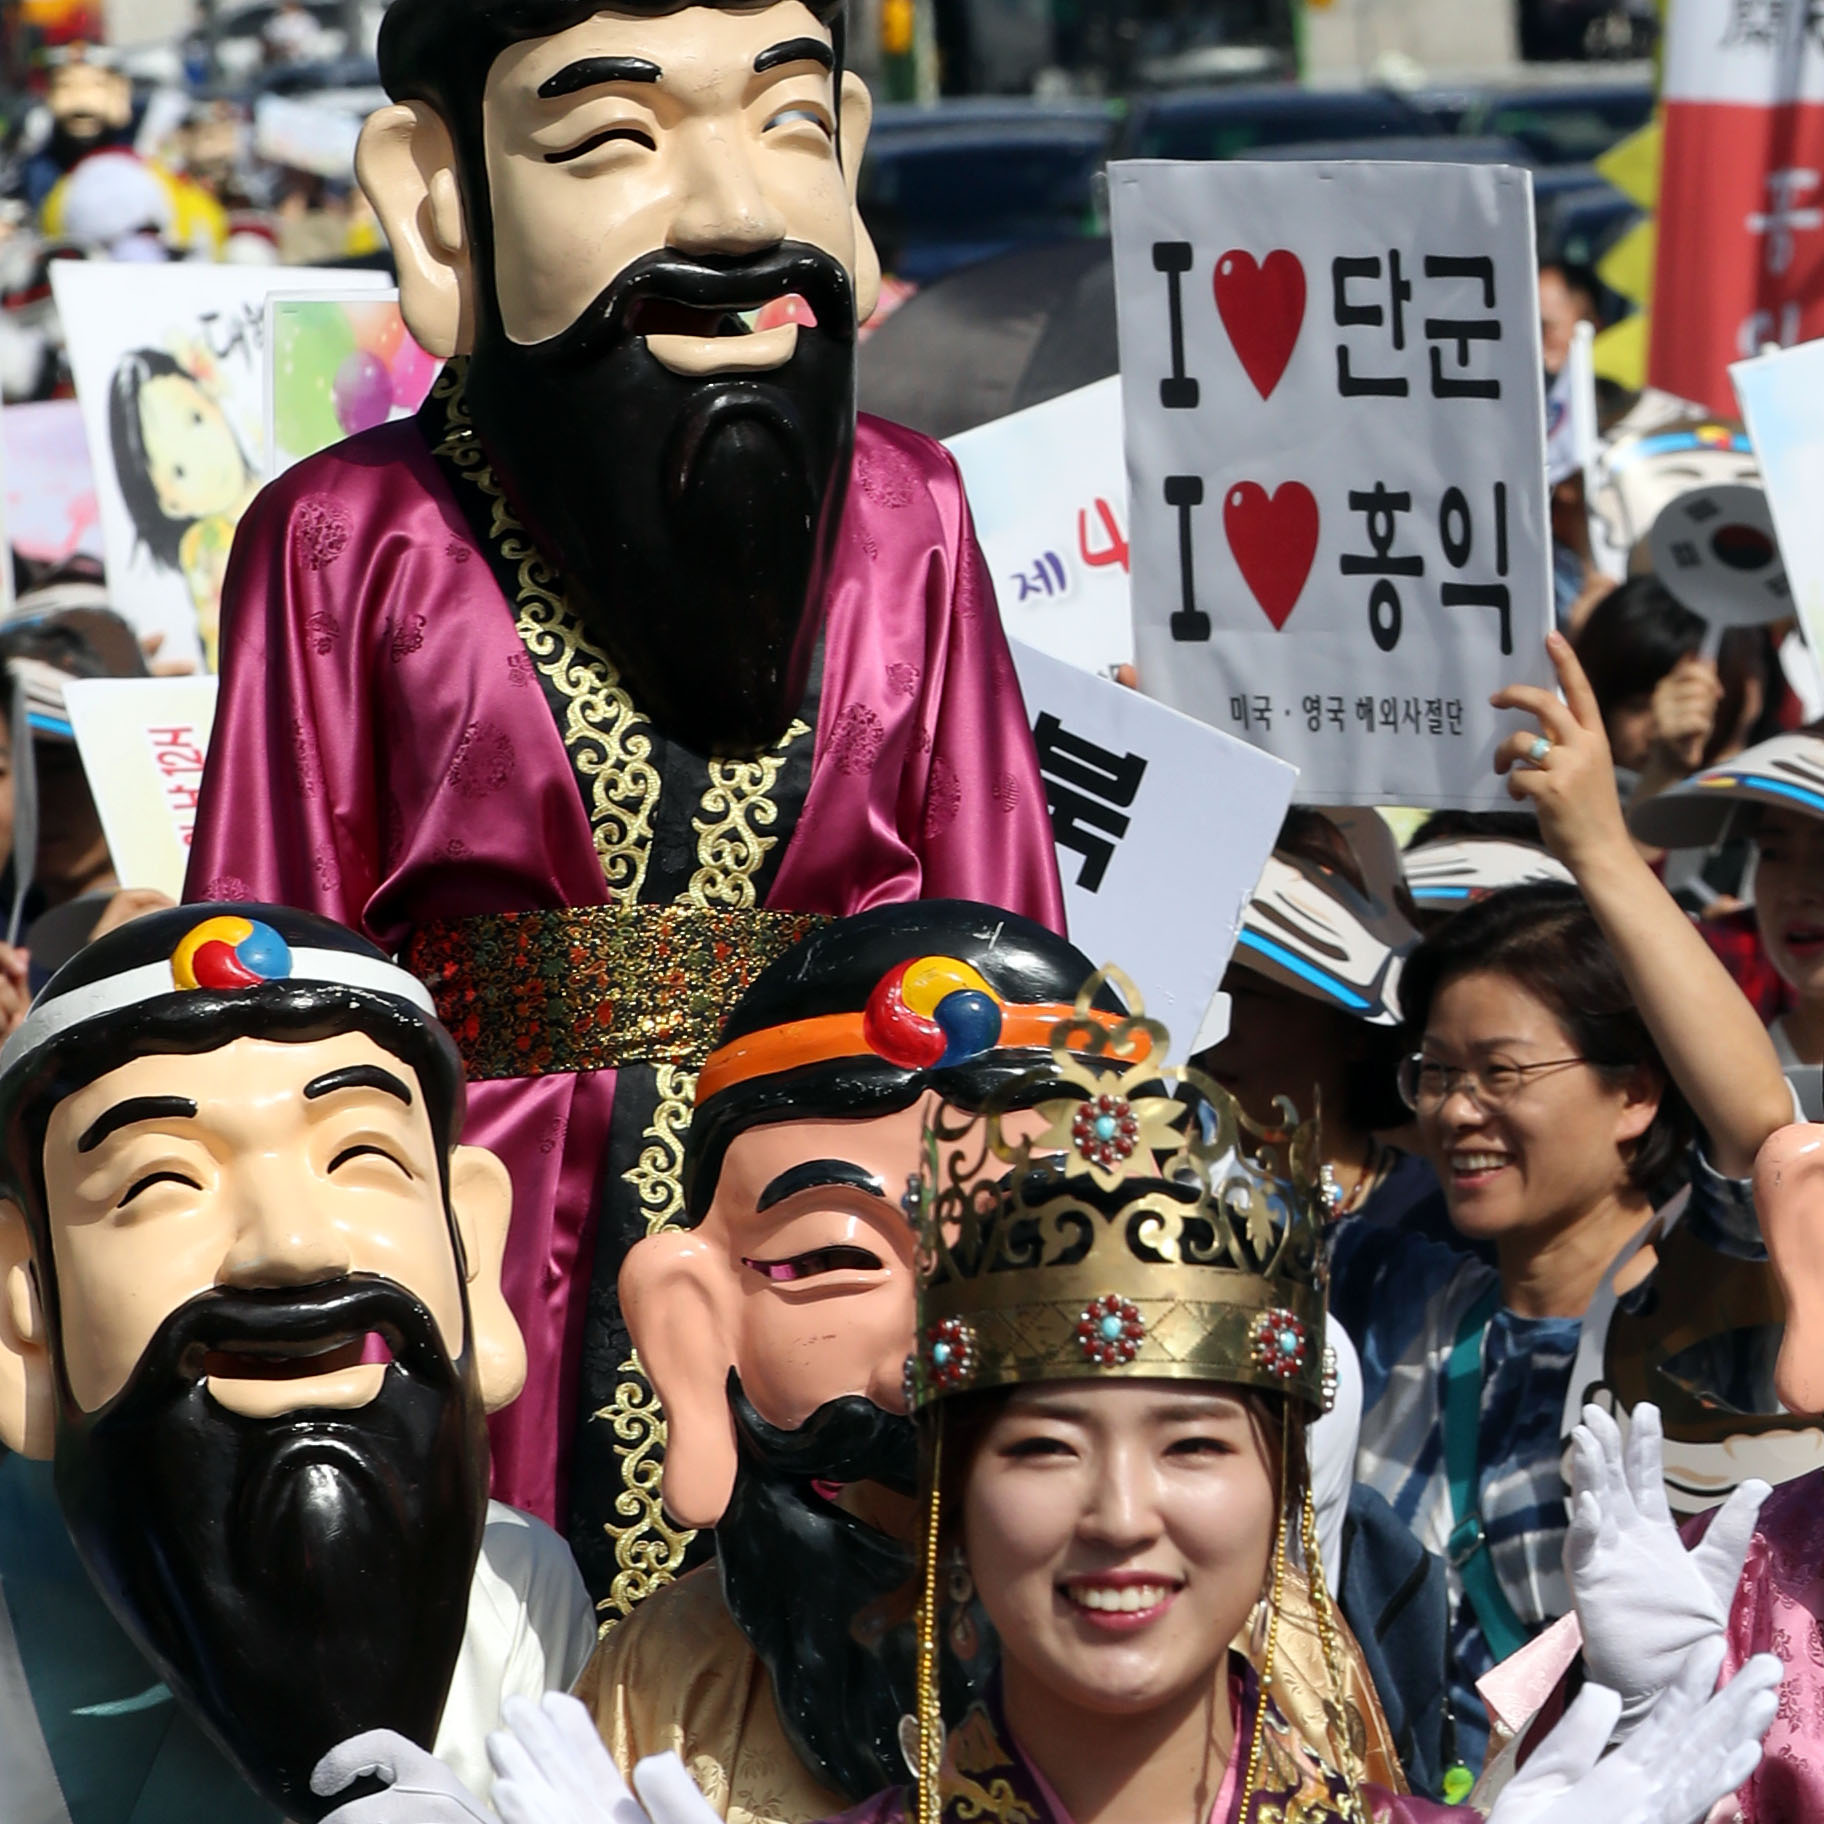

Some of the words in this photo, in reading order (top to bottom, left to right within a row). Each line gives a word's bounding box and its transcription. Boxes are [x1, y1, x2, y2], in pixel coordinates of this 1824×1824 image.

[1152, 241, 1200, 409] I
[1331, 248, 1501, 400] 단군
[1163, 475, 1212, 642] I
[1339, 480, 1513, 656] 홍익
[1229, 693, 1274, 733] 미국
[1301, 694, 1346, 734] 영국
[1354, 696, 1465, 736] 해외사절단
